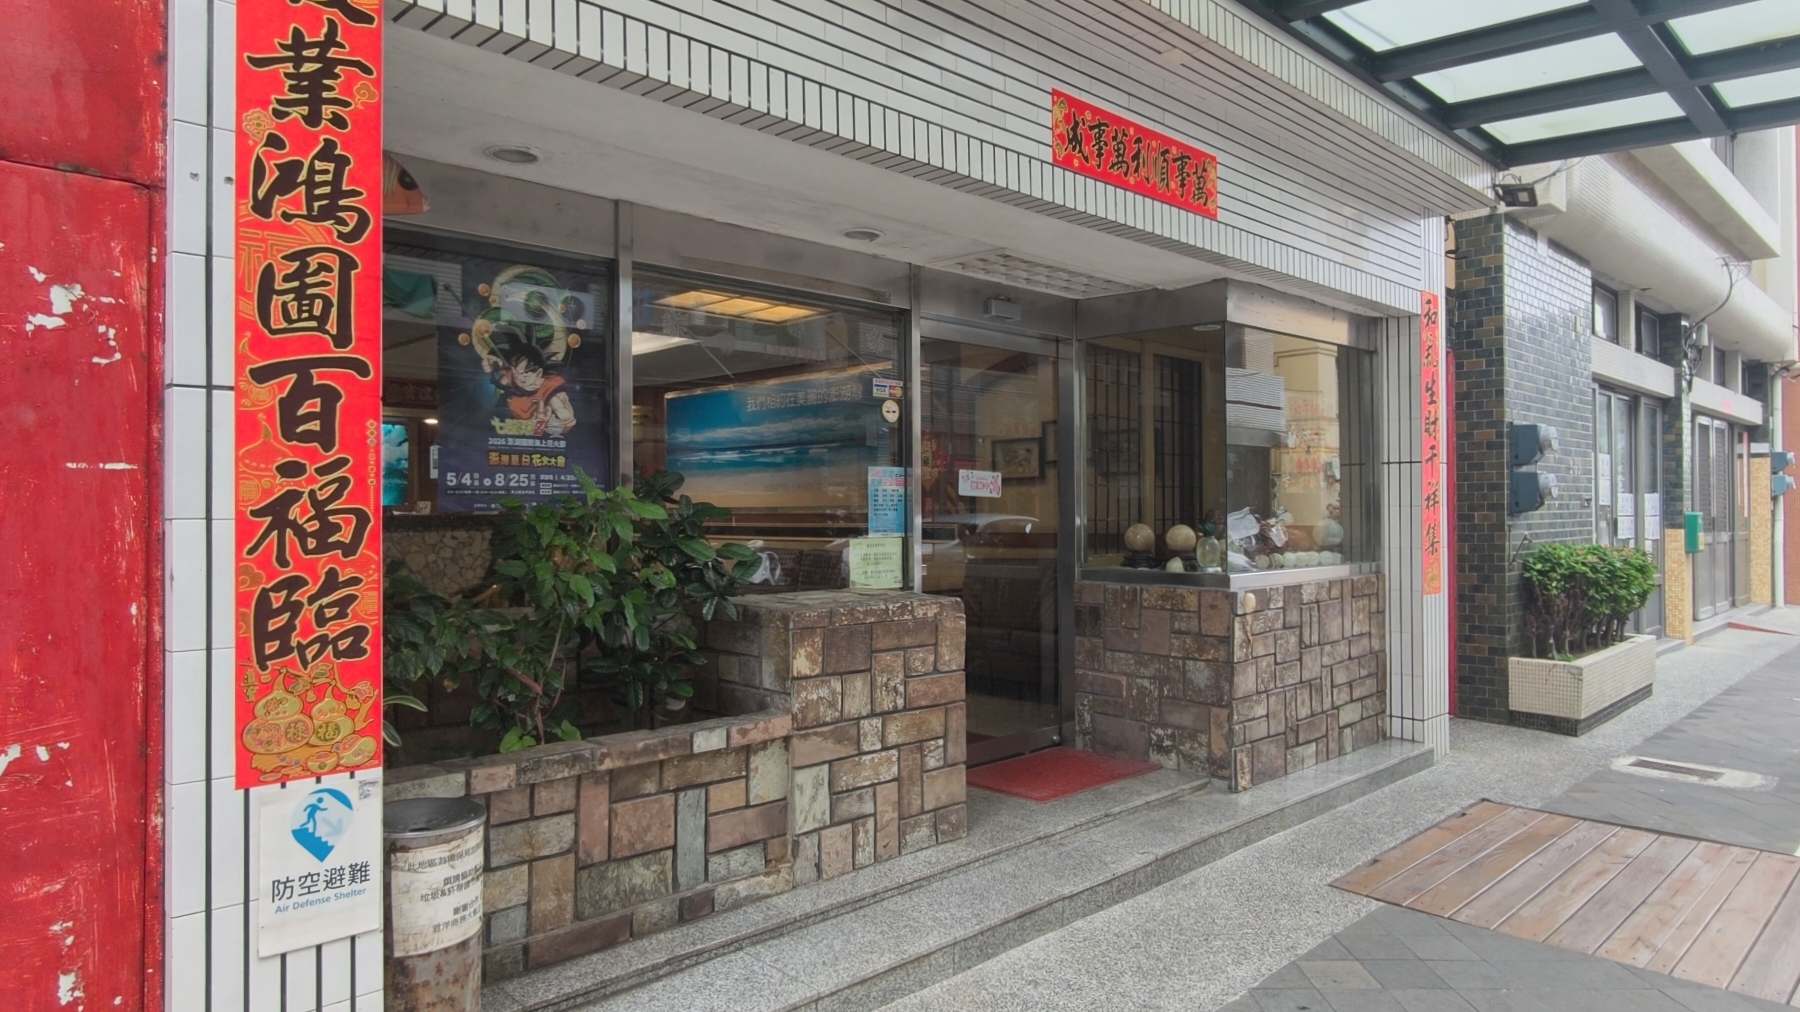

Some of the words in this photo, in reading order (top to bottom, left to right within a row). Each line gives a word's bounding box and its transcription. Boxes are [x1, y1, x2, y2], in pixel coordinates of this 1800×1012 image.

[488, 437, 506, 446] 2026
[446, 472, 472, 487] 5/4
[495, 473, 529, 488] 8/25
[271, 861, 371, 904] 防空避難
[275, 904, 290, 915] Air
[292, 895, 331, 911] Defense
[333, 887, 367, 902] Shelter
